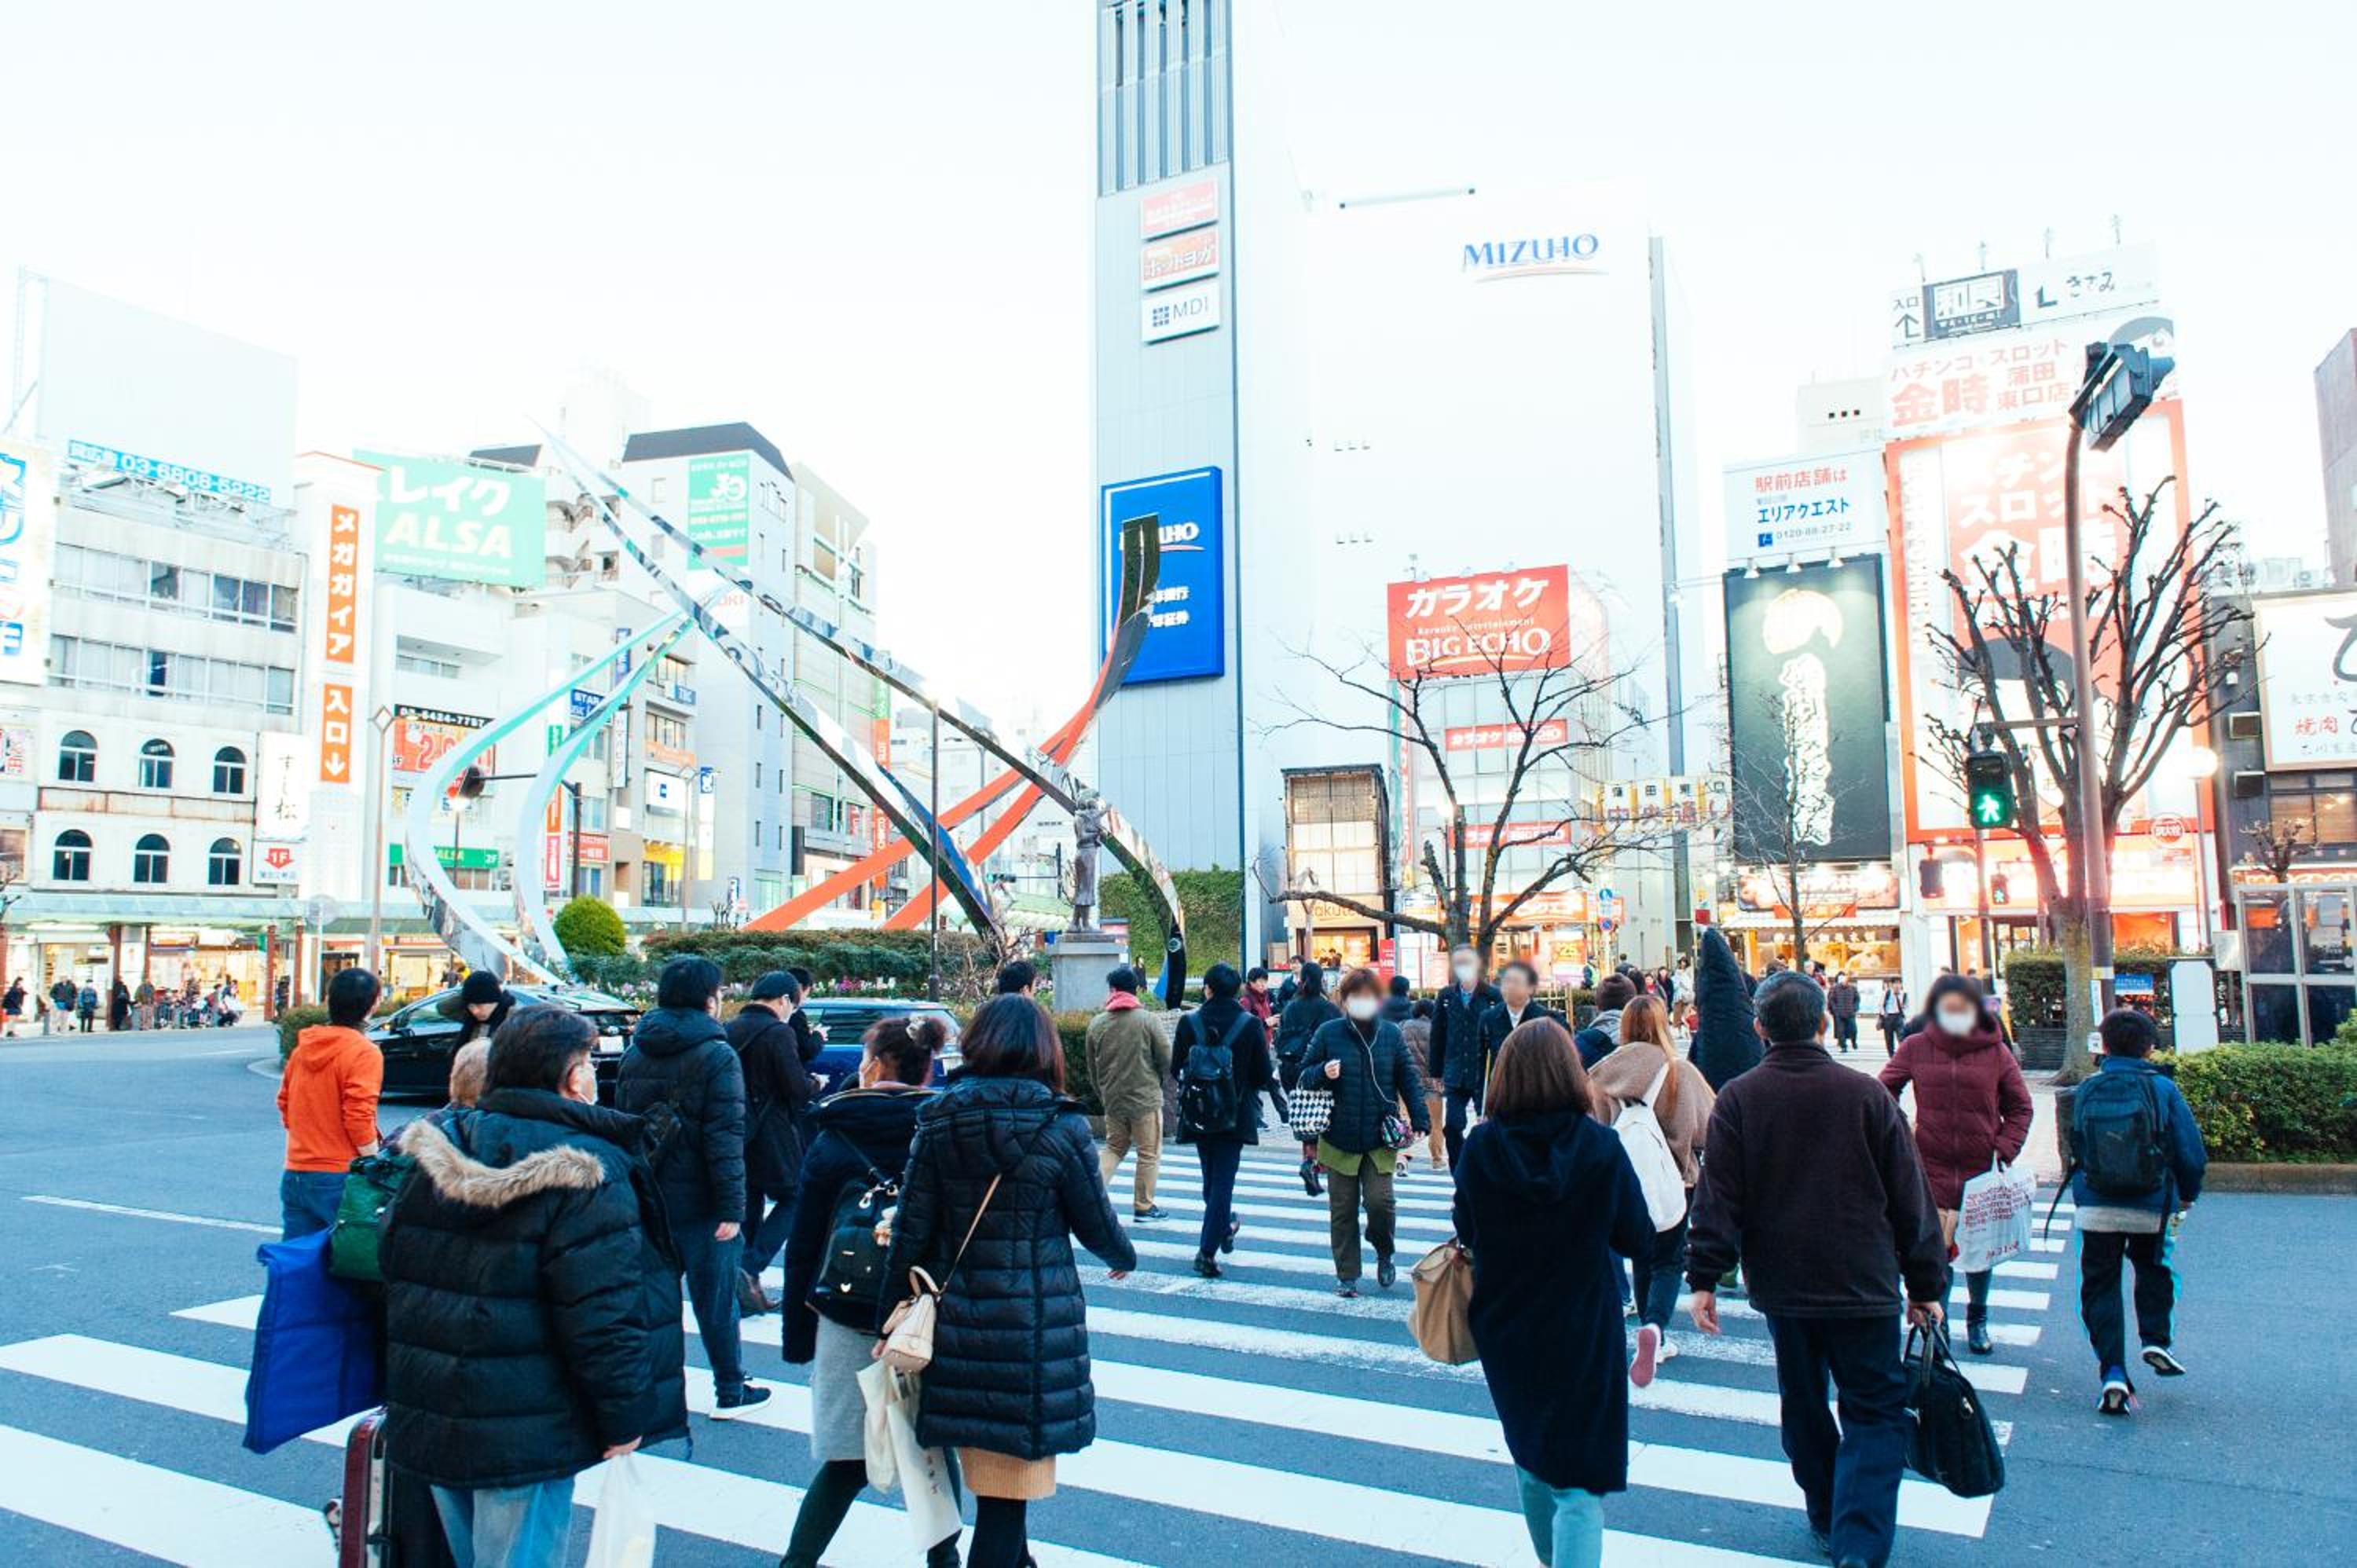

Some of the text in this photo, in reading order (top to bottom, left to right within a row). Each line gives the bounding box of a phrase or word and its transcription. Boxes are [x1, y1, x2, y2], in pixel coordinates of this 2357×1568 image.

[1462, 234, 1599, 273] MIZUHO
[1172, 296, 1208, 320] MDI
[2007, 361, 2056, 387] 蒲田
[1890, 372, 1988, 428] 金時
[1998, 383, 2070, 411] 東口店
[390, 466, 511, 517] レイク
[1755, 467, 1848, 493] 駅前店舗は
[1757, 496, 1850, 524] エリアクエスト
[383, 511, 513, 559] ALSA
[329, 512, 356, 655] メガガイア
[1405, 577, 1549, 619] カラオケ
[1406, 628, 1552, 668] BIG ECHO
[325, 689, 350, 744] 入口
[275, 753, 298, 820] すし松
[270, 853, 288, 863] 1F
